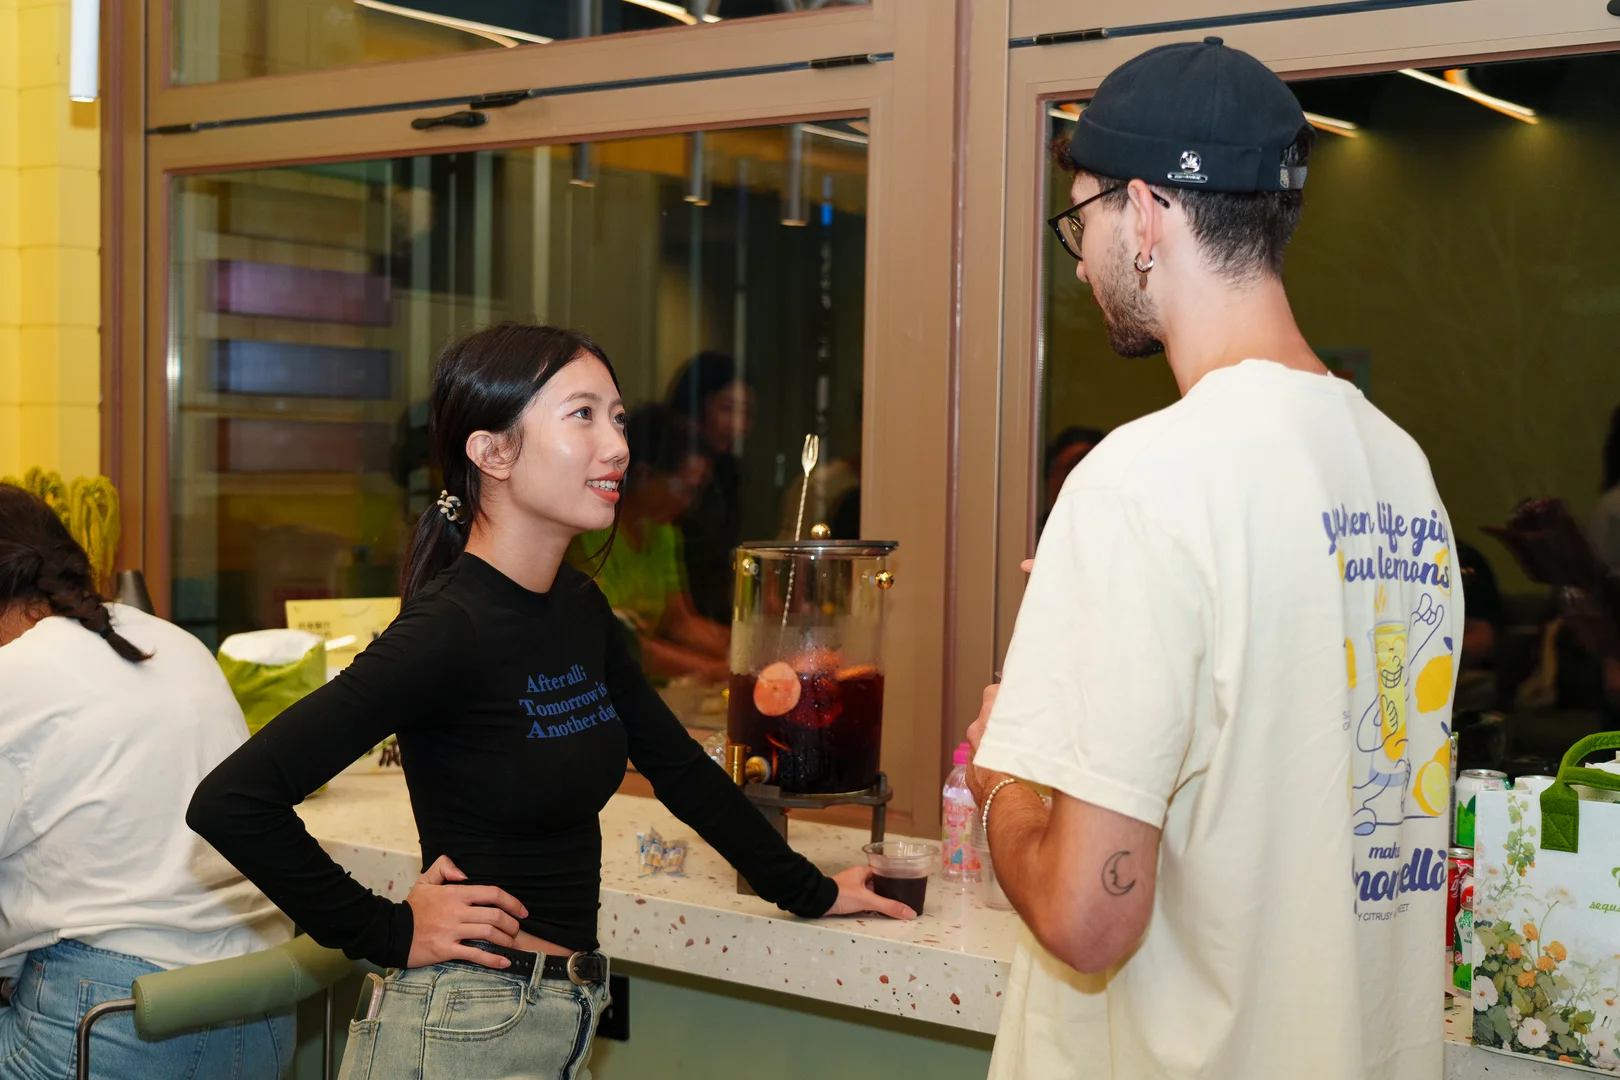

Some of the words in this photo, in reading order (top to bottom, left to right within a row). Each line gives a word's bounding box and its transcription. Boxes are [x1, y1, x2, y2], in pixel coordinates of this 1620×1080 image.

[1377, 501, 1408, 554] life
[1343, 556, 1376, 583] ou
[1378, 546, 1450, 589] lemons
[526, 673, 567, 692] After
[519, 688, 599, 717] Tomorrow
[526, 714, 598, 738] Another
